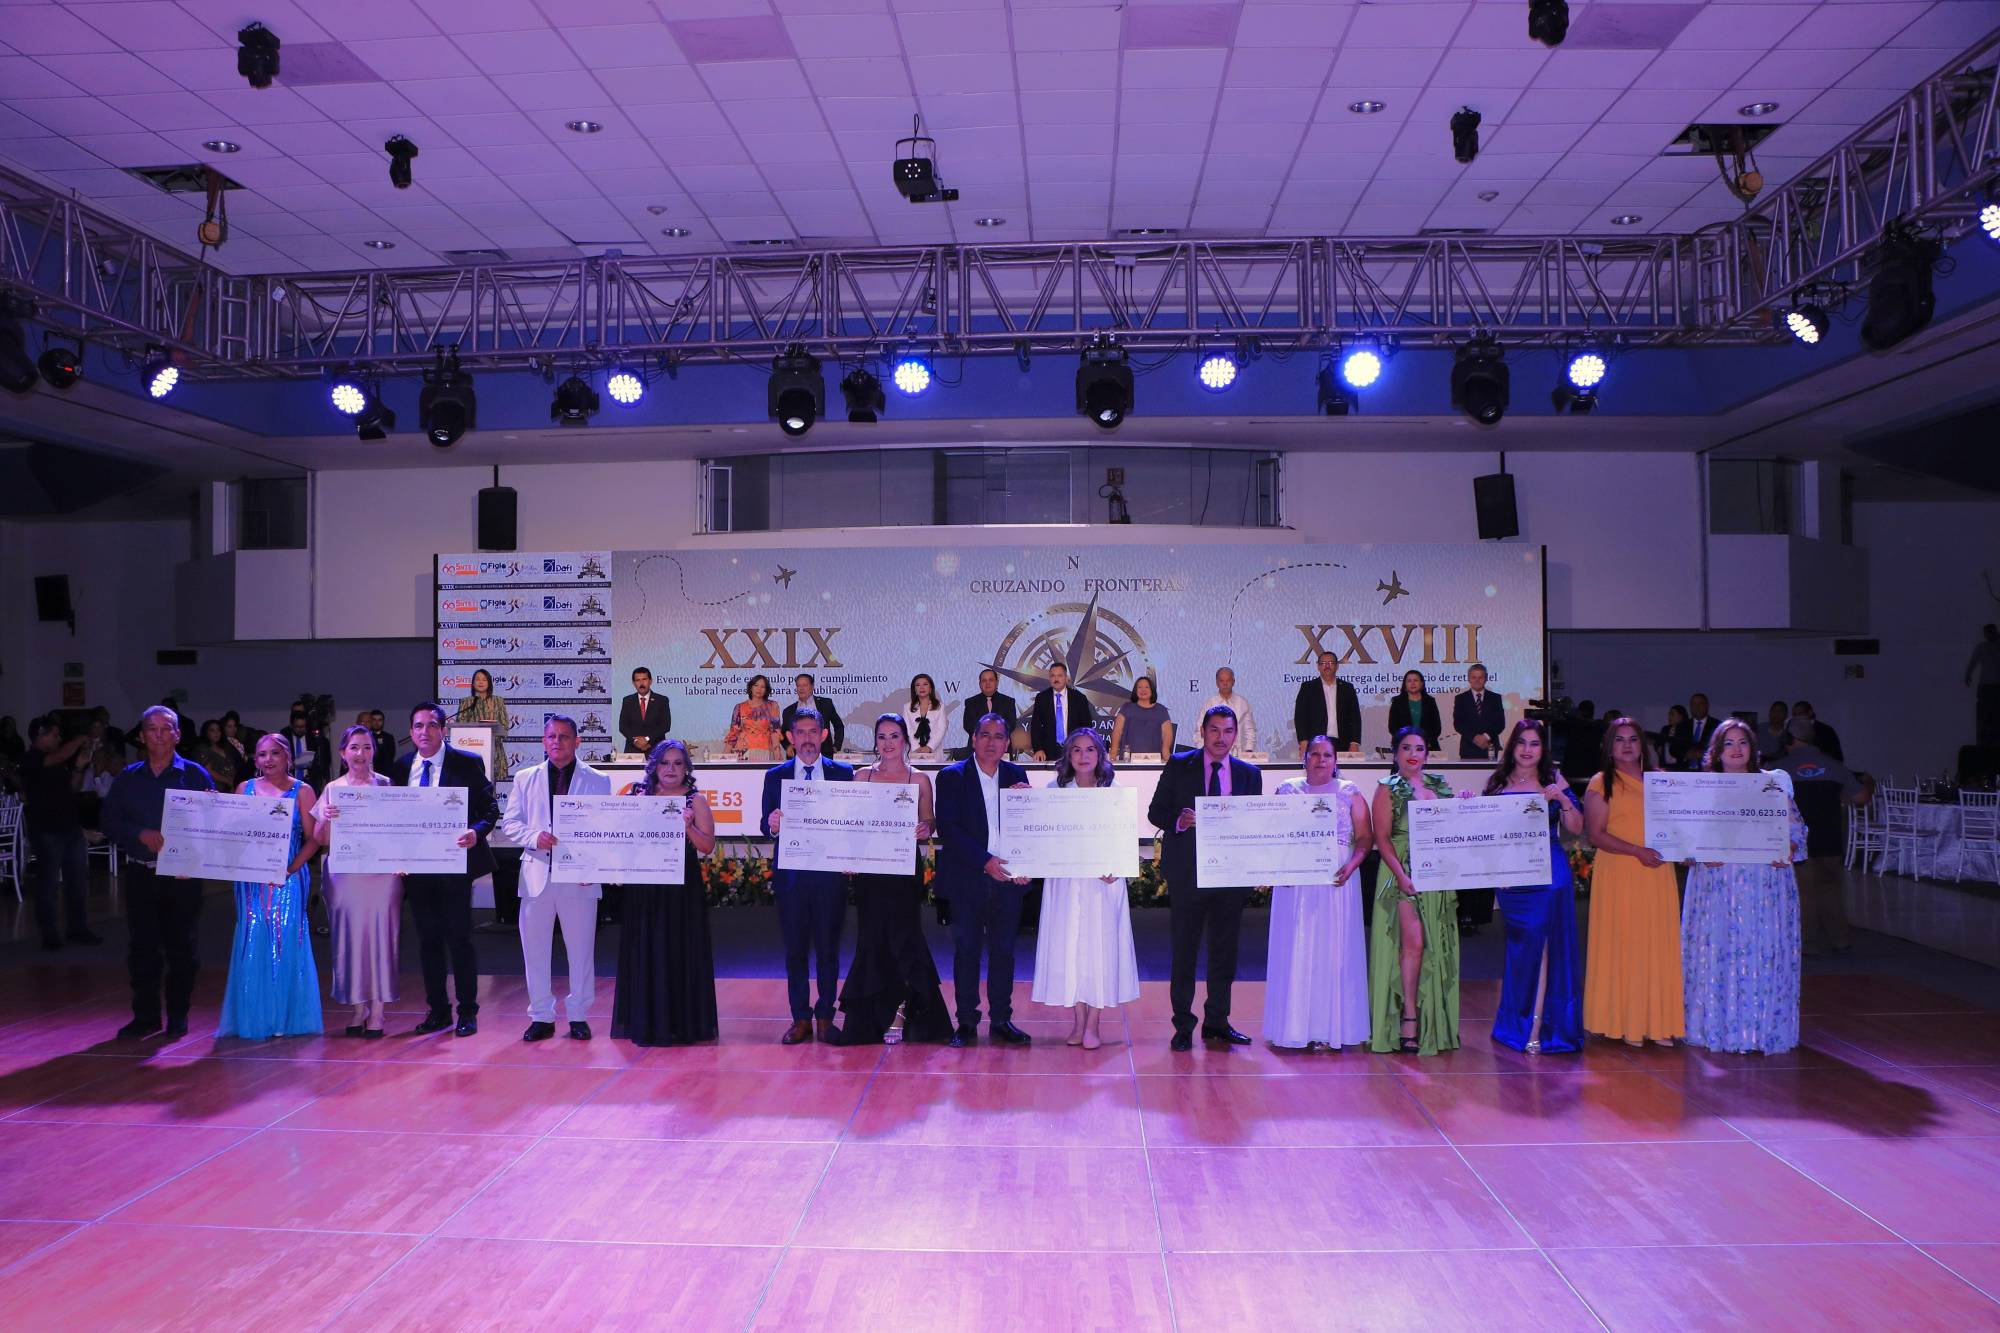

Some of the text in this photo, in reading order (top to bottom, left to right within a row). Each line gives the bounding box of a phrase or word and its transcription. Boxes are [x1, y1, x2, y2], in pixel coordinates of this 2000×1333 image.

[556, 564, 572, 572] Dafi
[1067, 556, 1080, 570] N
[969, 578, 1185, 593] CRUZANDO FRONTERAS
[556, 600, 572, 608] Dafi
[556, 639, 572, 648] Dafi
[699, 628, 843, 669] XXIX
[1294, 624, 1483, 665] XXVIII
[556, 677, 572, 686] Dafi
[656, 675, 689, 684] Evento
[691, 674, 703, 684] de
[705, 677, 728, 686] pago
[730, 674, 742, 684] de
[820, 673, 888, 685] cumplimiento
[1375, 673, 1389, 682] del
[1439, 673, 1450, 682] de
[685, 686, 718, 696] laboral
[770, 688, 791, 696] para
[813, 686, 858, 695] ubilación
[944, 680, 1200, 693] W E
[1363, 685, 1377, 694] del
[722, 792, 743, 807] 53
[1024, 824, 1055, 832] REGIÓN
[574, 830, 602, 838] REGIÓN
[604, 831, 634, 839] PIAXTLA
[1434, 835, 1465, 844] REGIÓN
[1467, 834, 1495, 842] AHOME
